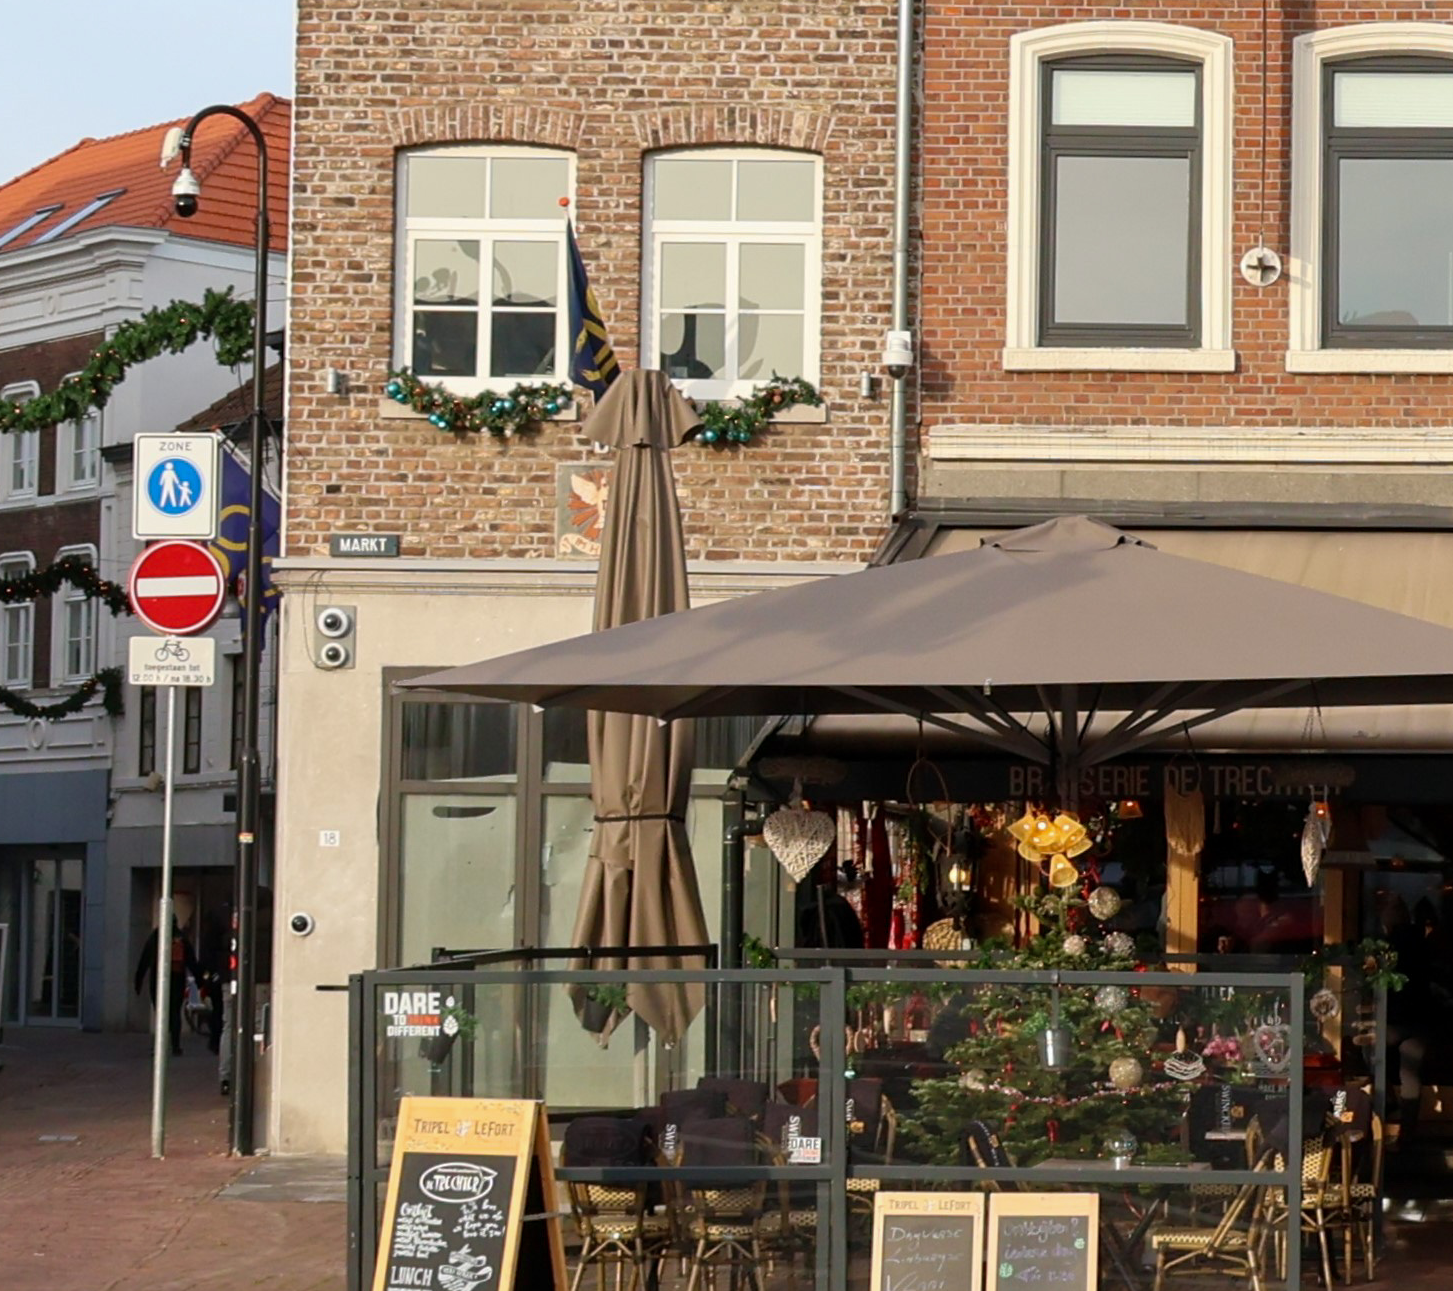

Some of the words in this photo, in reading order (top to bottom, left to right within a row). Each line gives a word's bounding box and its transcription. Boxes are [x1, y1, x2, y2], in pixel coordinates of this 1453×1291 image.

[159, 441, 192, 452] ZONE
[339, 537, 387, 552] MARKT
[1010, 765, 1150, 796] BRSERIE
[384, 991, 441, 1015] DARE
[392, 1014, 406, 1026] TO
[386, 1025, 441, 1037] DIFFERENT
[390, 1266, 433, 1286] LUNCH
